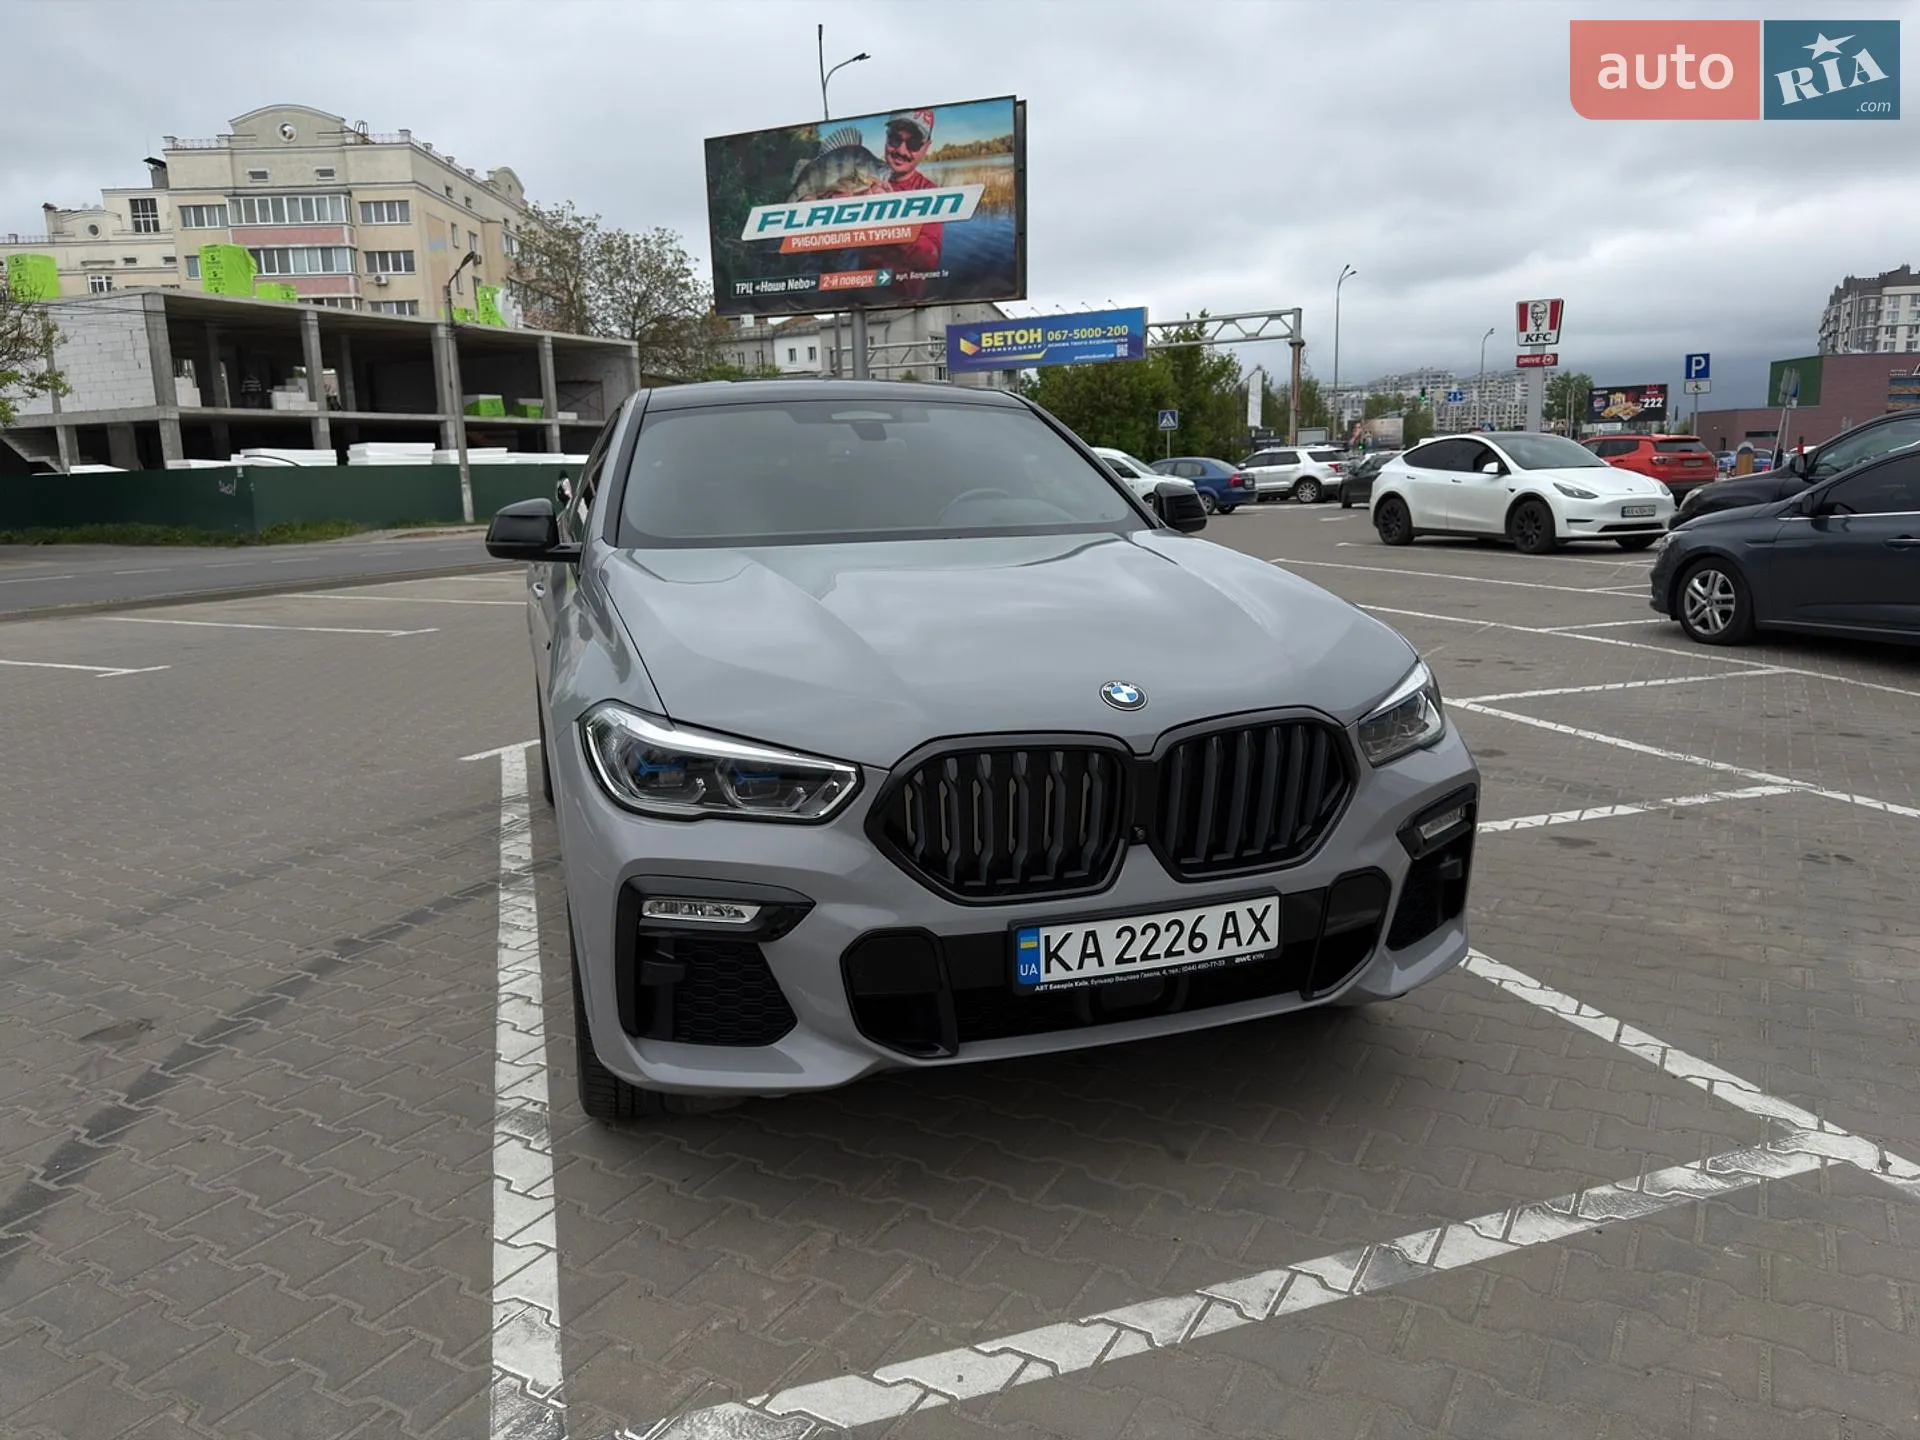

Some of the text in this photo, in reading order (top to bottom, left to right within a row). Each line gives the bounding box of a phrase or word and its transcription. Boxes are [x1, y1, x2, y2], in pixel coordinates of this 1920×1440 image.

[757, 192, 964, 233] FLAGMAN
[791, 227, 912, 249] РИБОЛОВЛЯ ТА ТУРИЗМ
[823, 274, 874, 287] 2-й поверх
[735, 283, 754, 295] ТРЦ
[981, 328, 1042, 347] БЕТОН
[1047, 325, 1128, 341] 067-5000-200
[1524, 332, 1552, 343] KFC
[1691, 356, 1706, 378] P
[1644, 398, 1664, 408] 222
[1044, 904, 1272, 974] KA 2226 AX
[1019, 963, 1038, 976] UA
